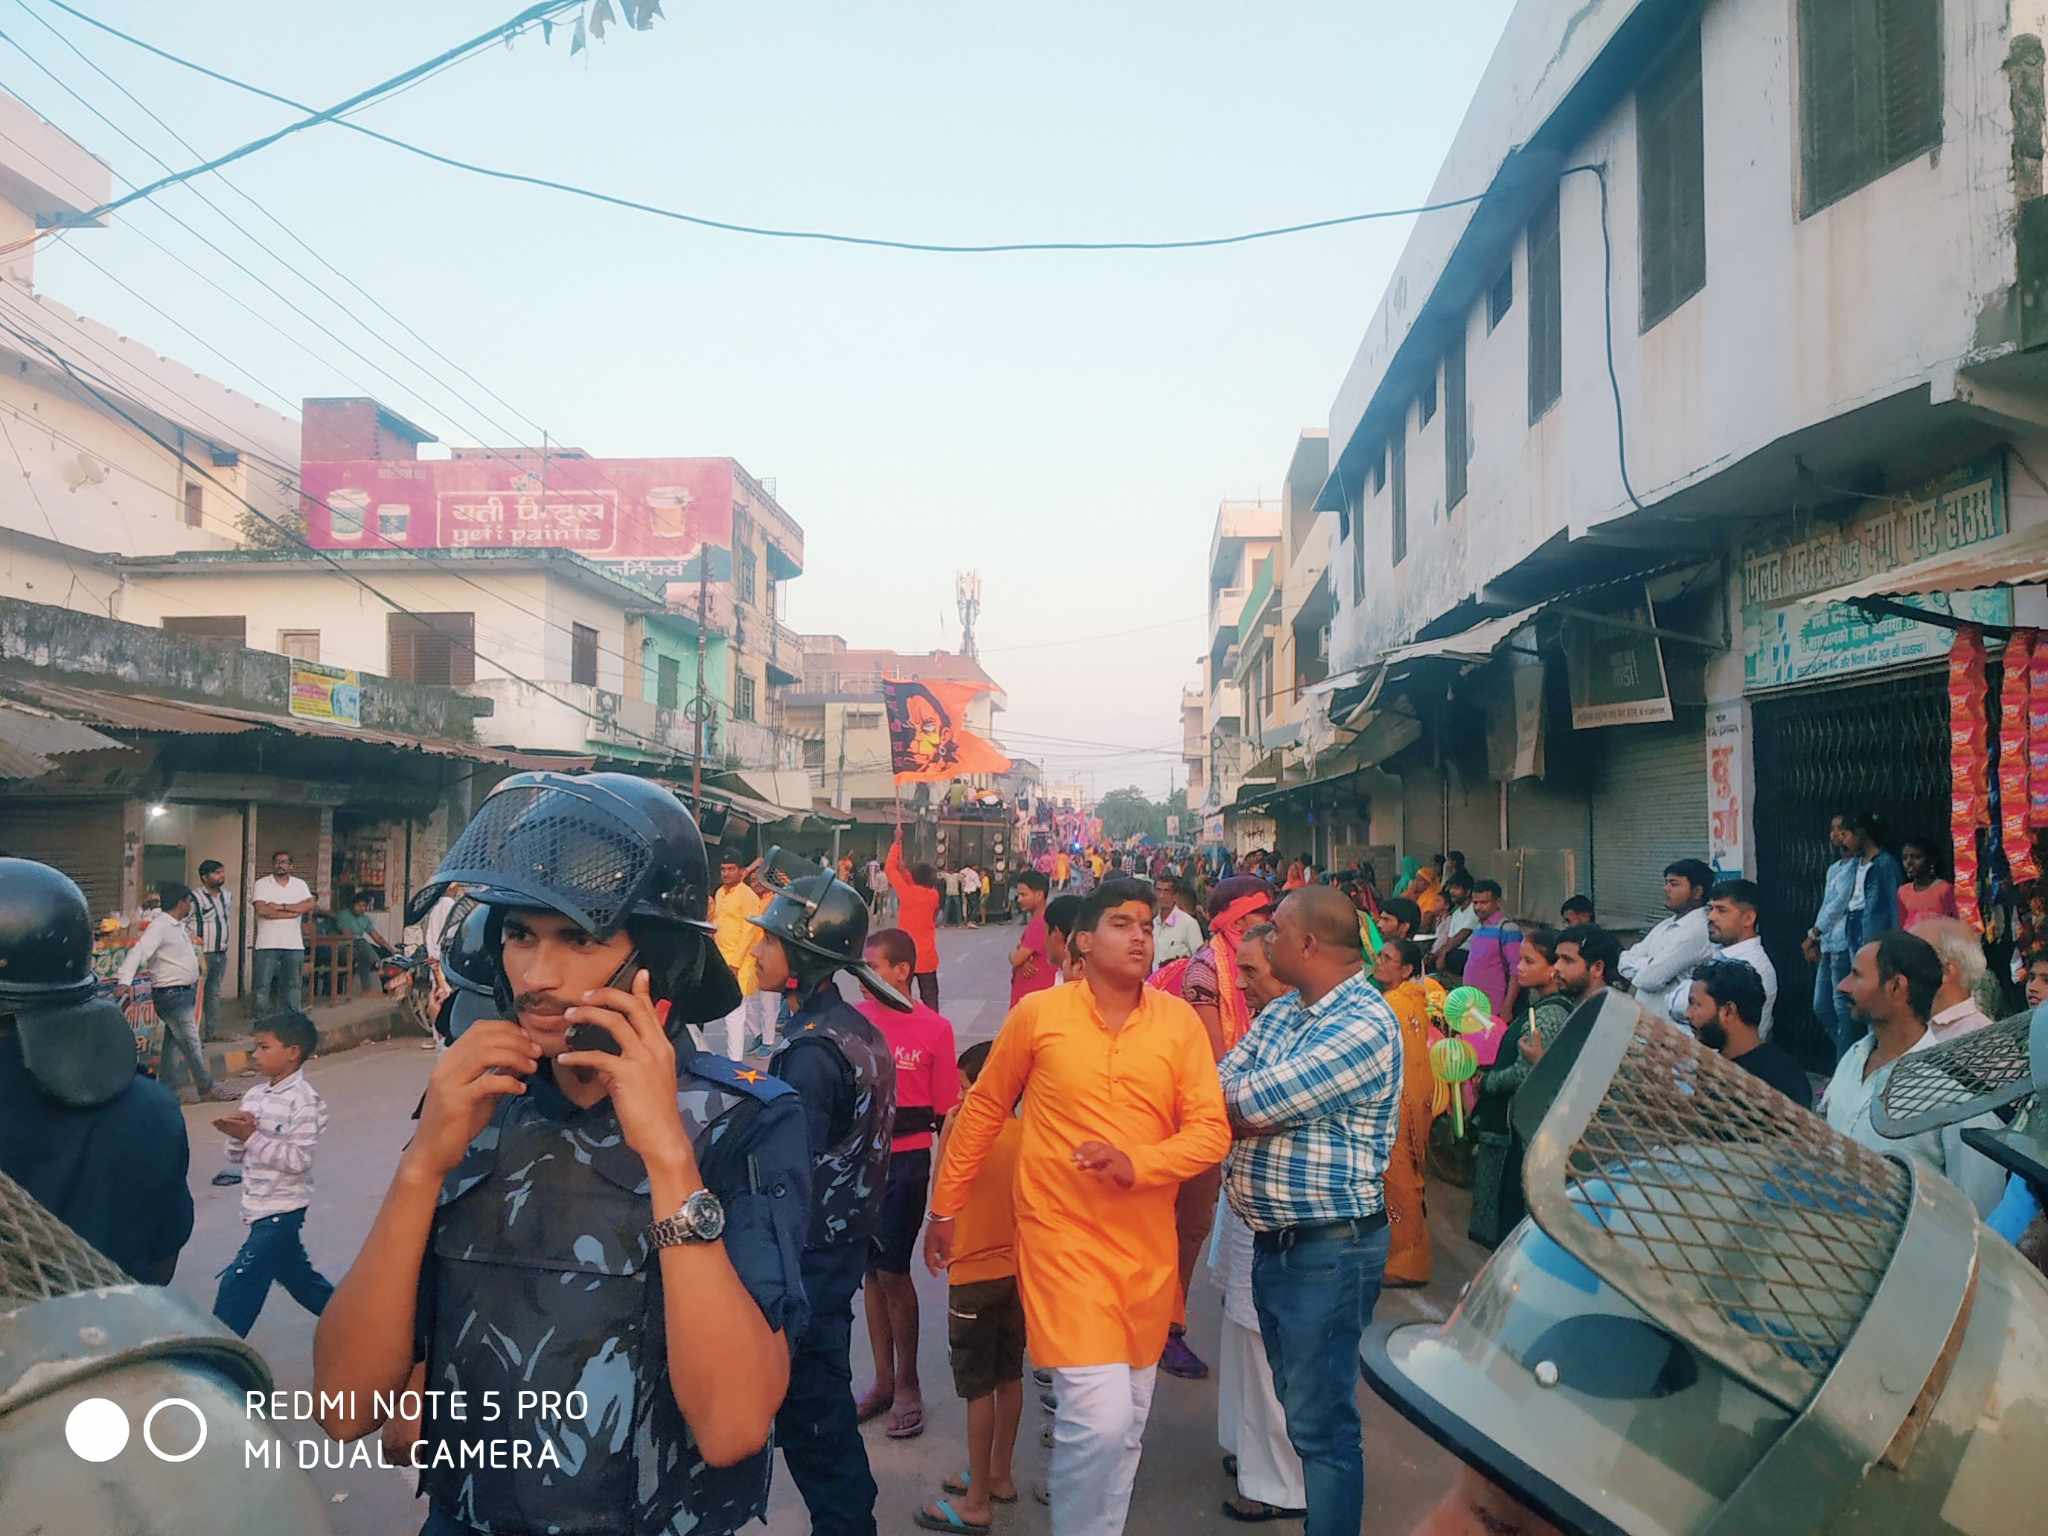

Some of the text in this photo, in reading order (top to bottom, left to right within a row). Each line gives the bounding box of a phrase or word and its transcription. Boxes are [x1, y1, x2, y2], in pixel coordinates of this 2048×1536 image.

[452, 525, 600, 549] yeti paints
[1943, 478, 1996, 550] हाउस
